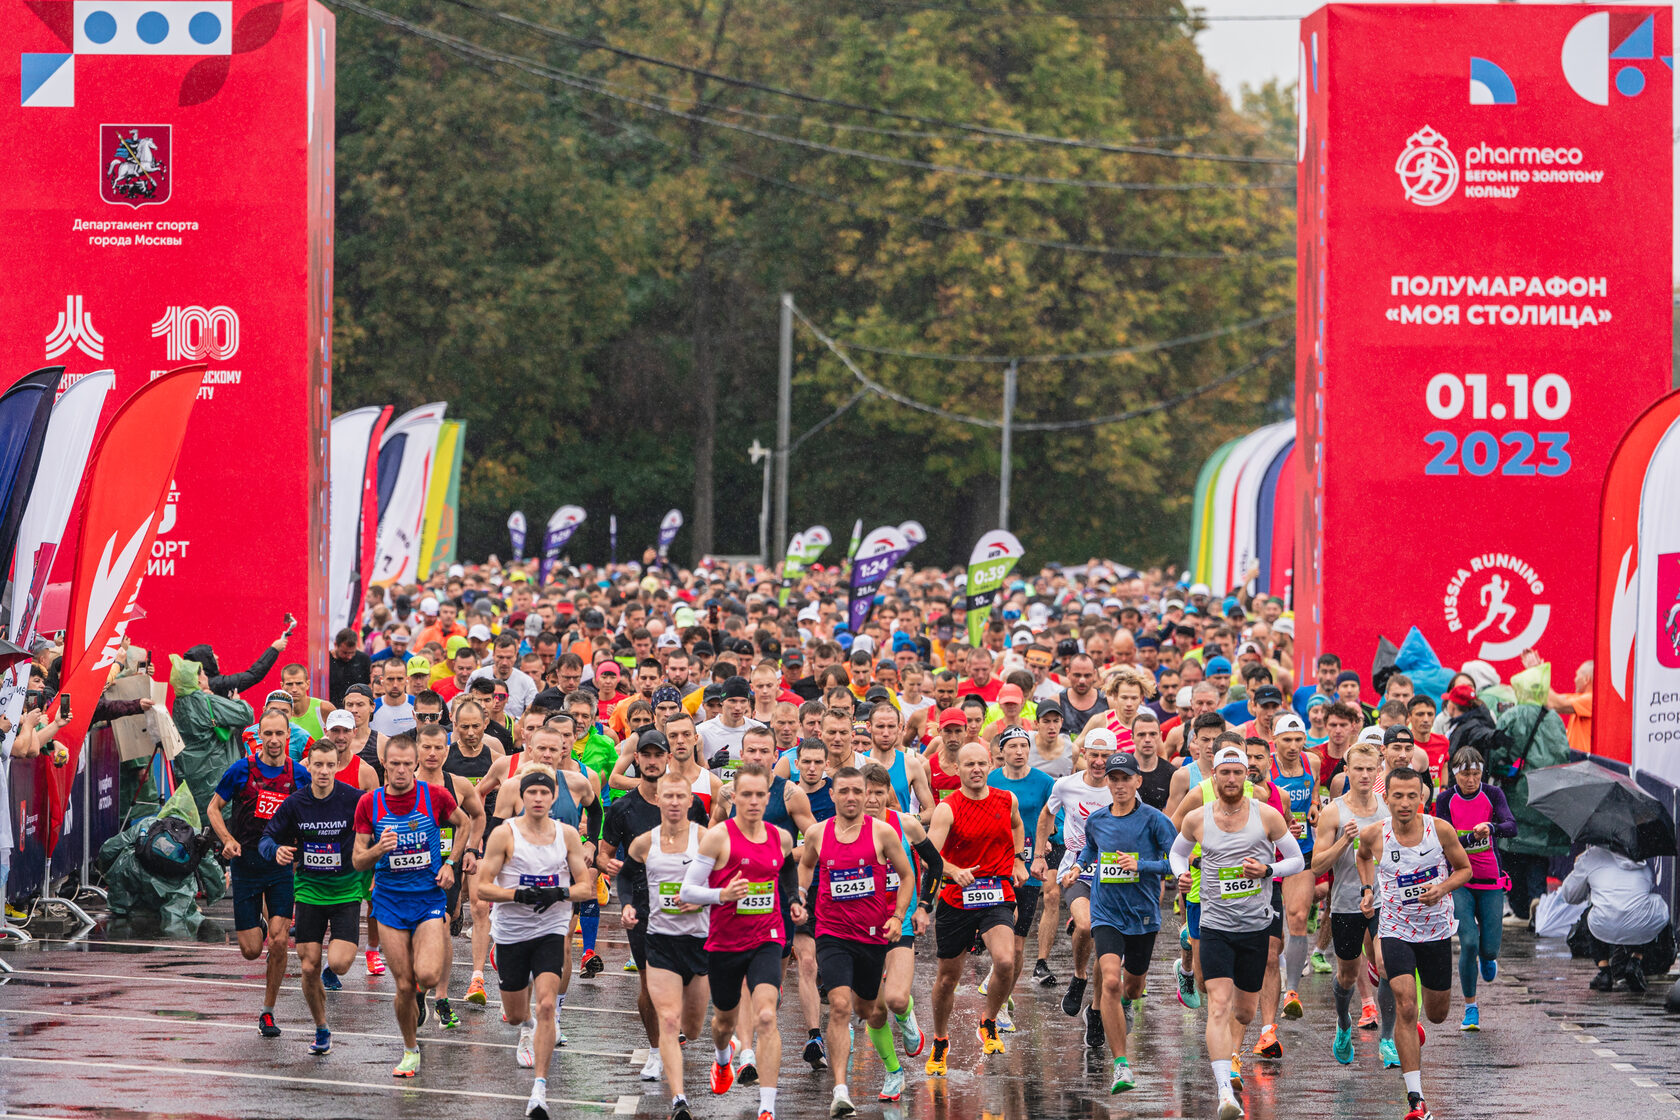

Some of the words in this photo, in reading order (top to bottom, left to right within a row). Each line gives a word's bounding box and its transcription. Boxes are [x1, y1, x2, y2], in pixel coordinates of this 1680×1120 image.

[1465, 141, 1583, 169] pharmeco
[1465, 170, 1508, 182] БЕГОМ
[1510, 170, 1530, 182] ПО
[1532, 171, 1604, 183] ЗОЛОТОМУ
[1465, 186, 1520, 199] КОЛЬЦУ
[72, 219, 153, 232] Департамент
[156, 221, 199, 232] спорта
[88, 236, 132, 247] города
[134, 235, 182, 246] Москвы
[1391, 276, 1607, 297] ПОЛУМАРАФОН
[1385, 305, 1460, 325] «МОЯ
[1467, 305, 1612, 329] СТОЛИЦА»
[151, 306, 240, 360] 100
[1425, 373, 1572, 420] 01.10
[1424, 430, 1572, 477] 2023
[151, 541, 190, 558] ОРТ
[860, 557, 888, 578] 1:24
[974, 565, 1006, 585] 0:39
[1444, 568, 1471, 632] RUSSIA
[1470, 553, 1544, 595] RUNNING
[1650, 691, 1680, 707] Деп
[1290, 788, 1310, 801] SSIA
[297, 820, 347, 830] УРАЛХИМ
[398, 832, 428, 845] SSIA
[306, 855, 333, 864] 6026
[394, 856, 423, 866] 6342
[1103, 865, 1131, 876] 4074
[835, 882, 866, 893] 6243
[1224, 880, 1254, 891] 3662
[1404, 886, 1427, 898] 653
[742, 897, 771, 907] 4533
[968, 892, 994, 902] 5910
